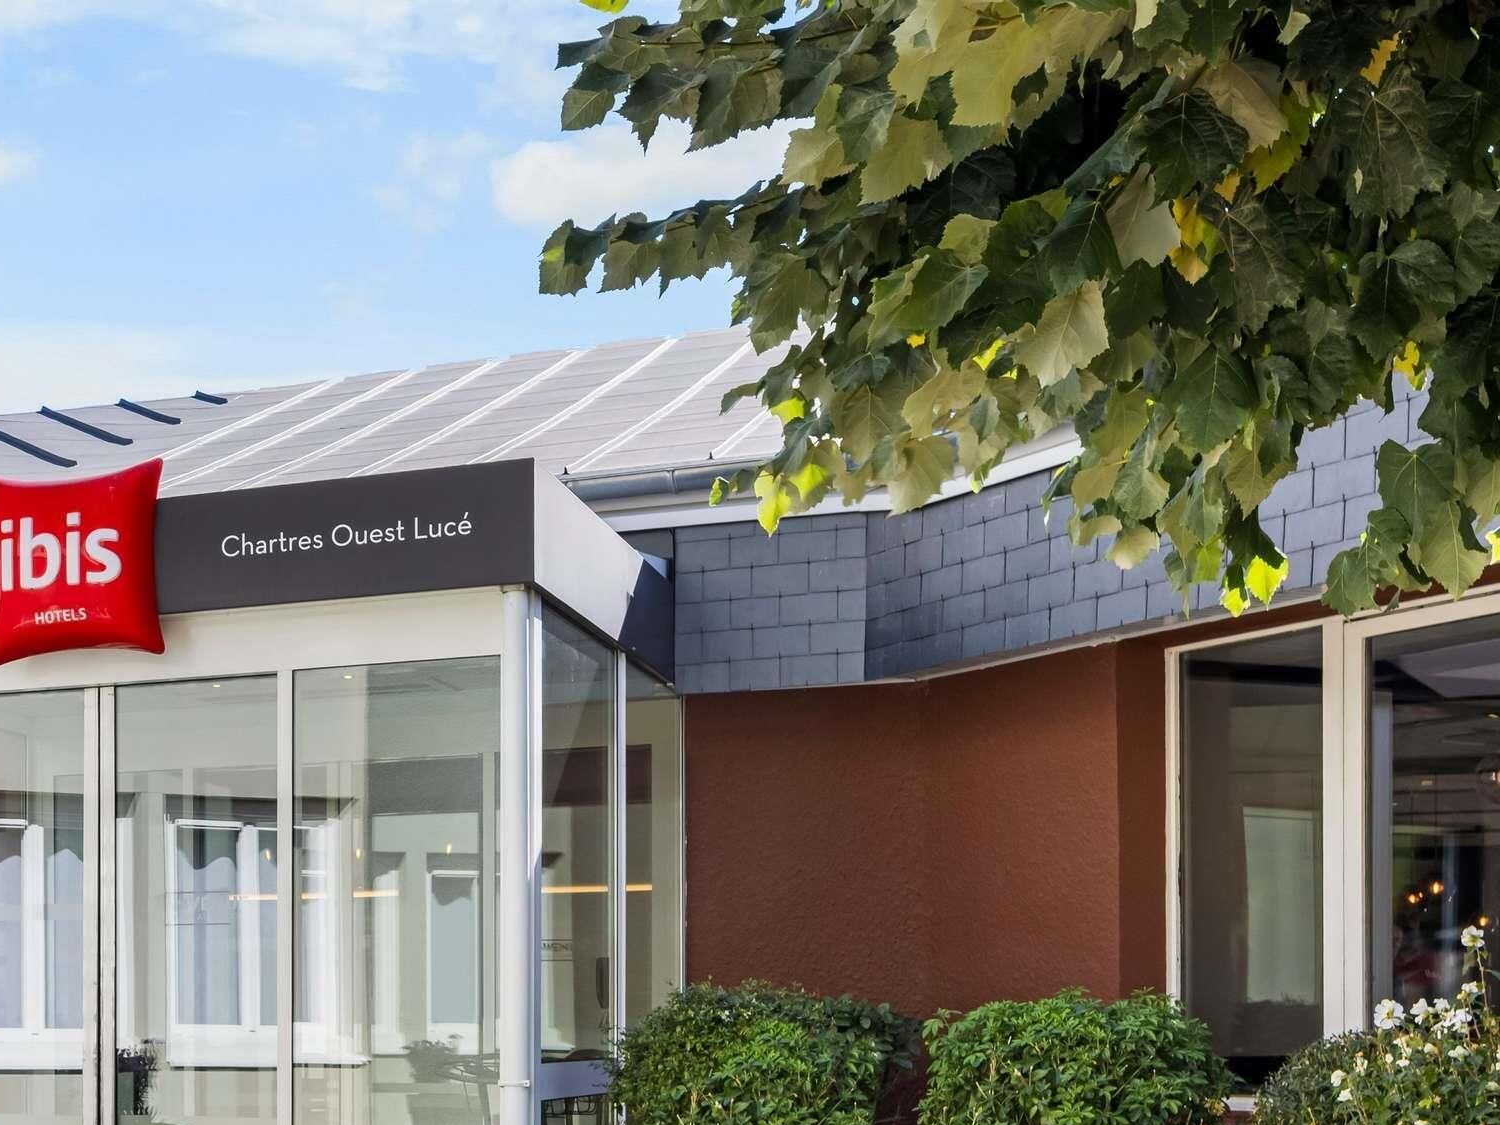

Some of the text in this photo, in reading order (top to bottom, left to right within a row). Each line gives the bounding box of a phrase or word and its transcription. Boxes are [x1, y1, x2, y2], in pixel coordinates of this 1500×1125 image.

[0, 511, 122, 592] ibis
[221, 511, 472, 557] Chartres Ouest Lucé
[34, 607, 87, 625] HOTELS
